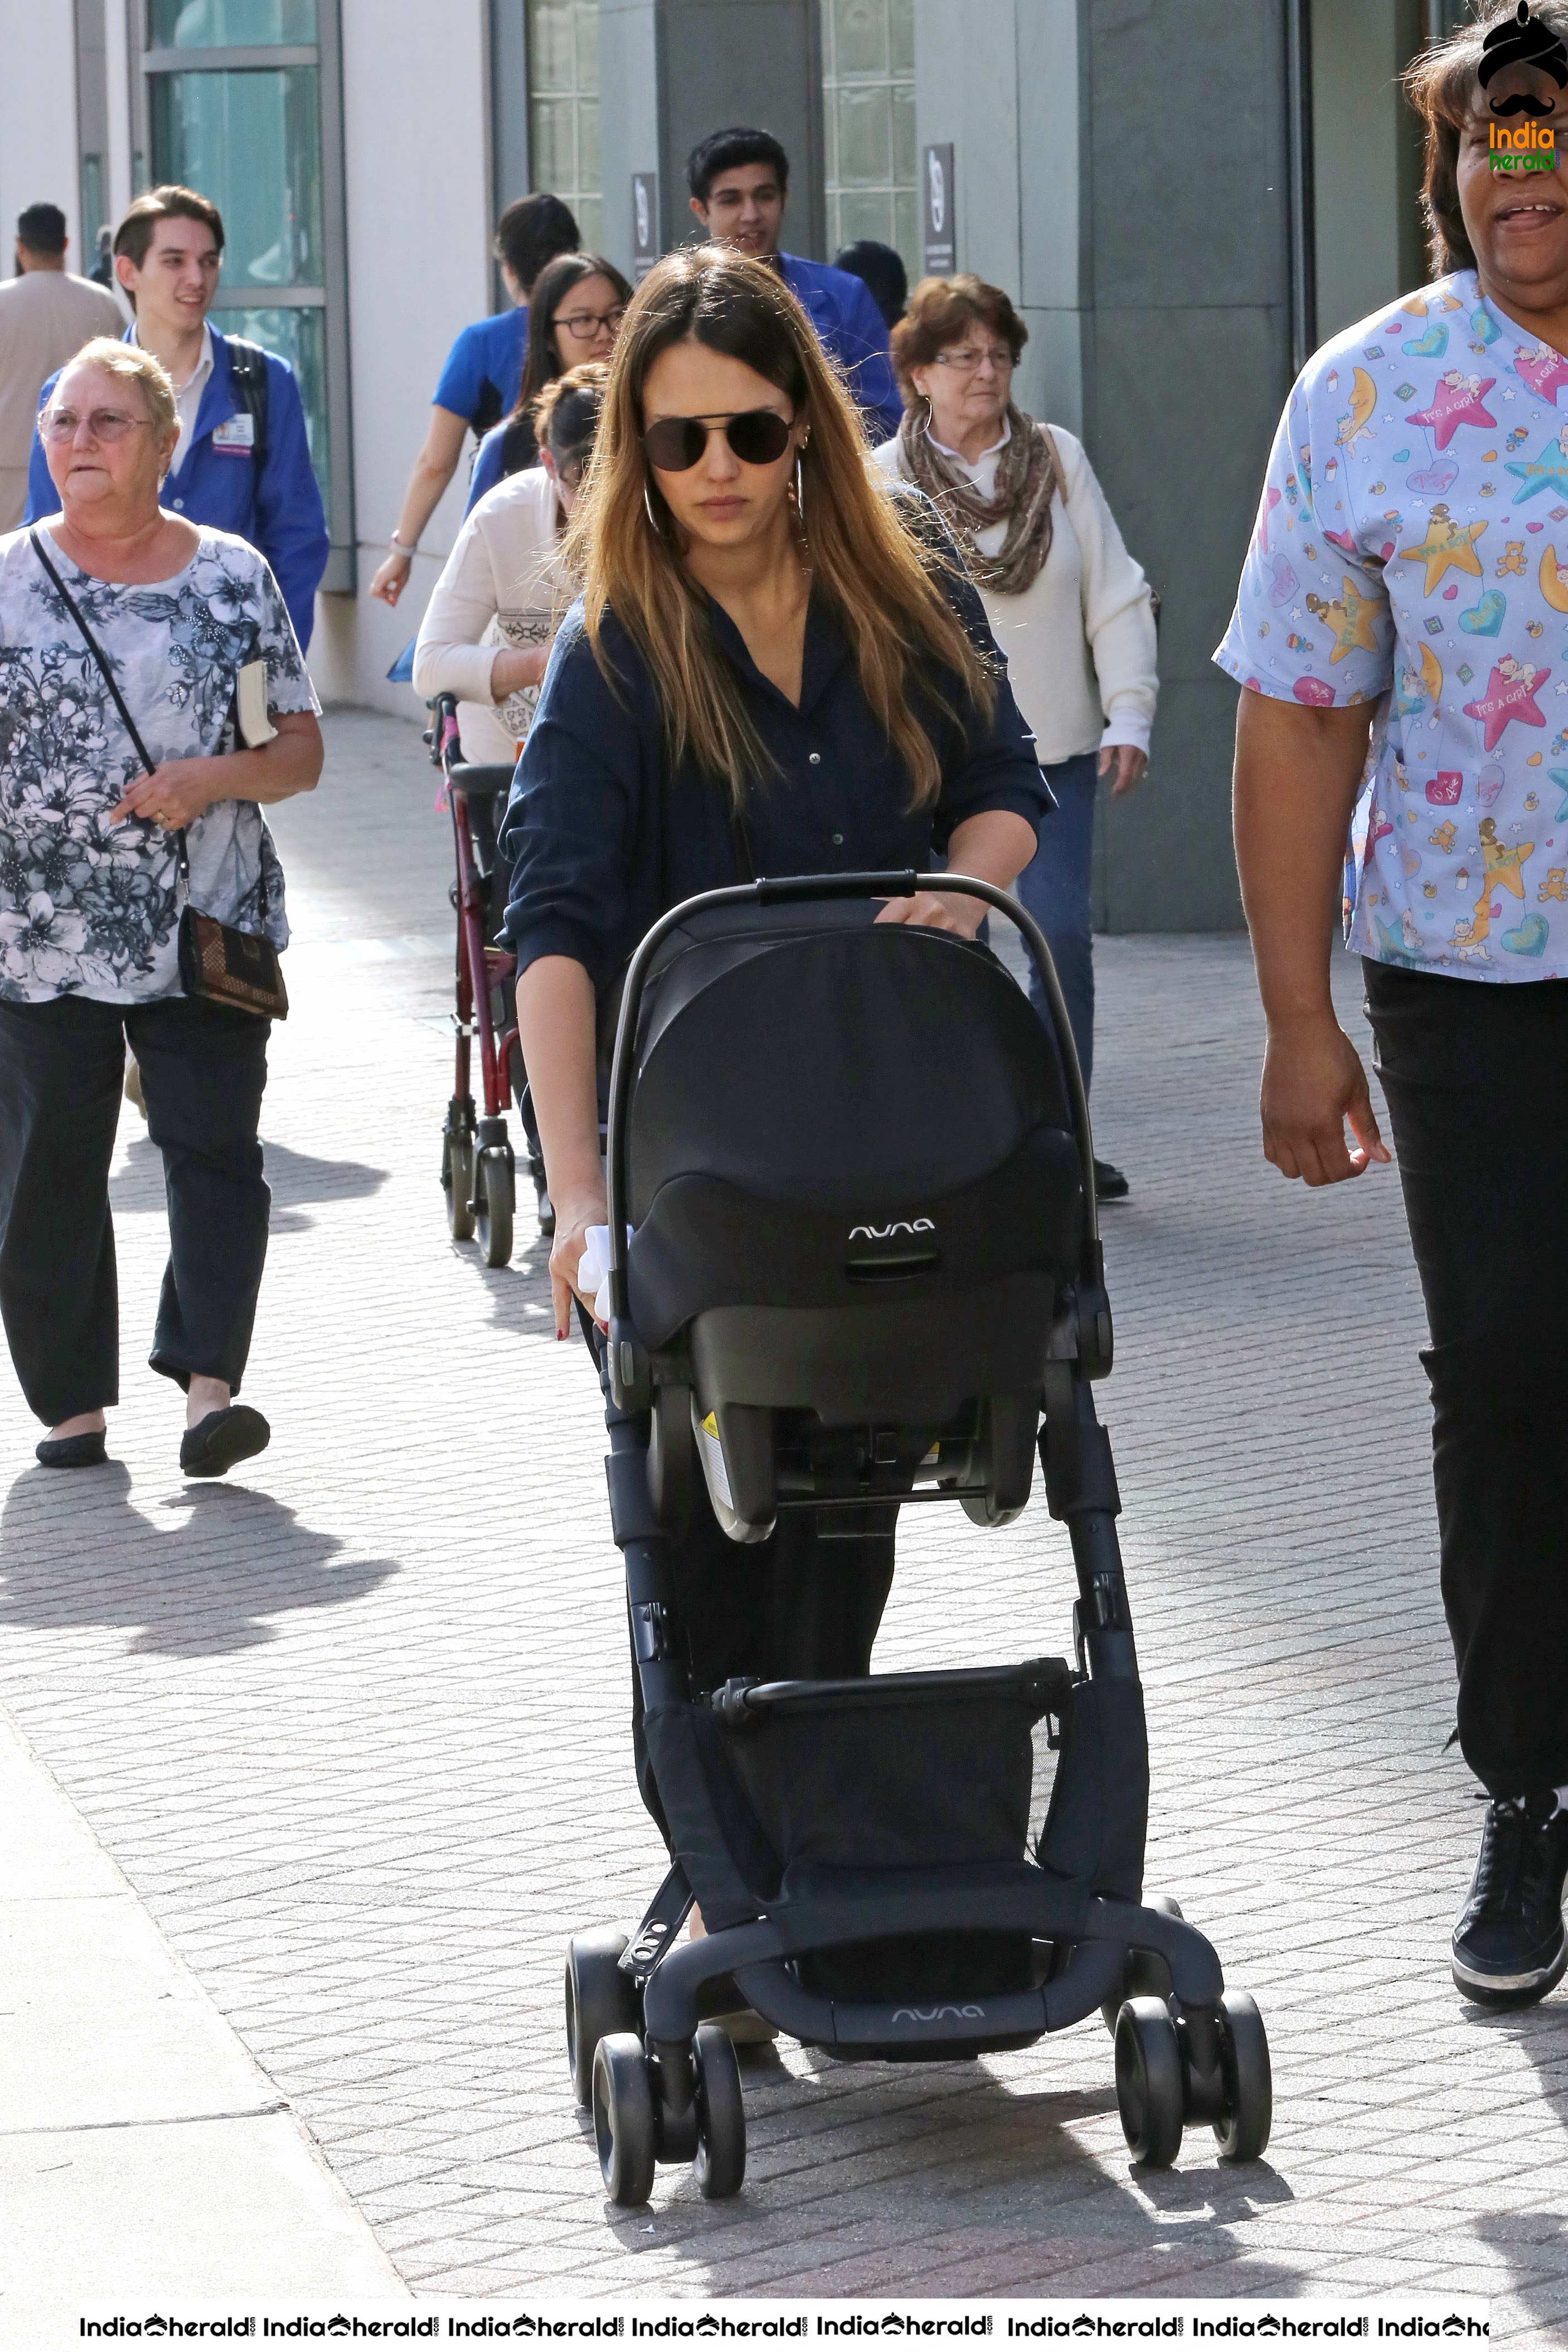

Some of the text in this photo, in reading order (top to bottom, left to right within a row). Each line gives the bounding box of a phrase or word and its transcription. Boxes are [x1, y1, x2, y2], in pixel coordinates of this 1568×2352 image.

[1422, 409, 1443, 423] IT'S
[1445, 406, 1453, 415] A
[1476, 702, 1494, 717] IT'S
[1498, 699, 1505, 710] A
[848, 1218, 935, 1240] nuna
[892, 2005, 986, 2023] nuna
